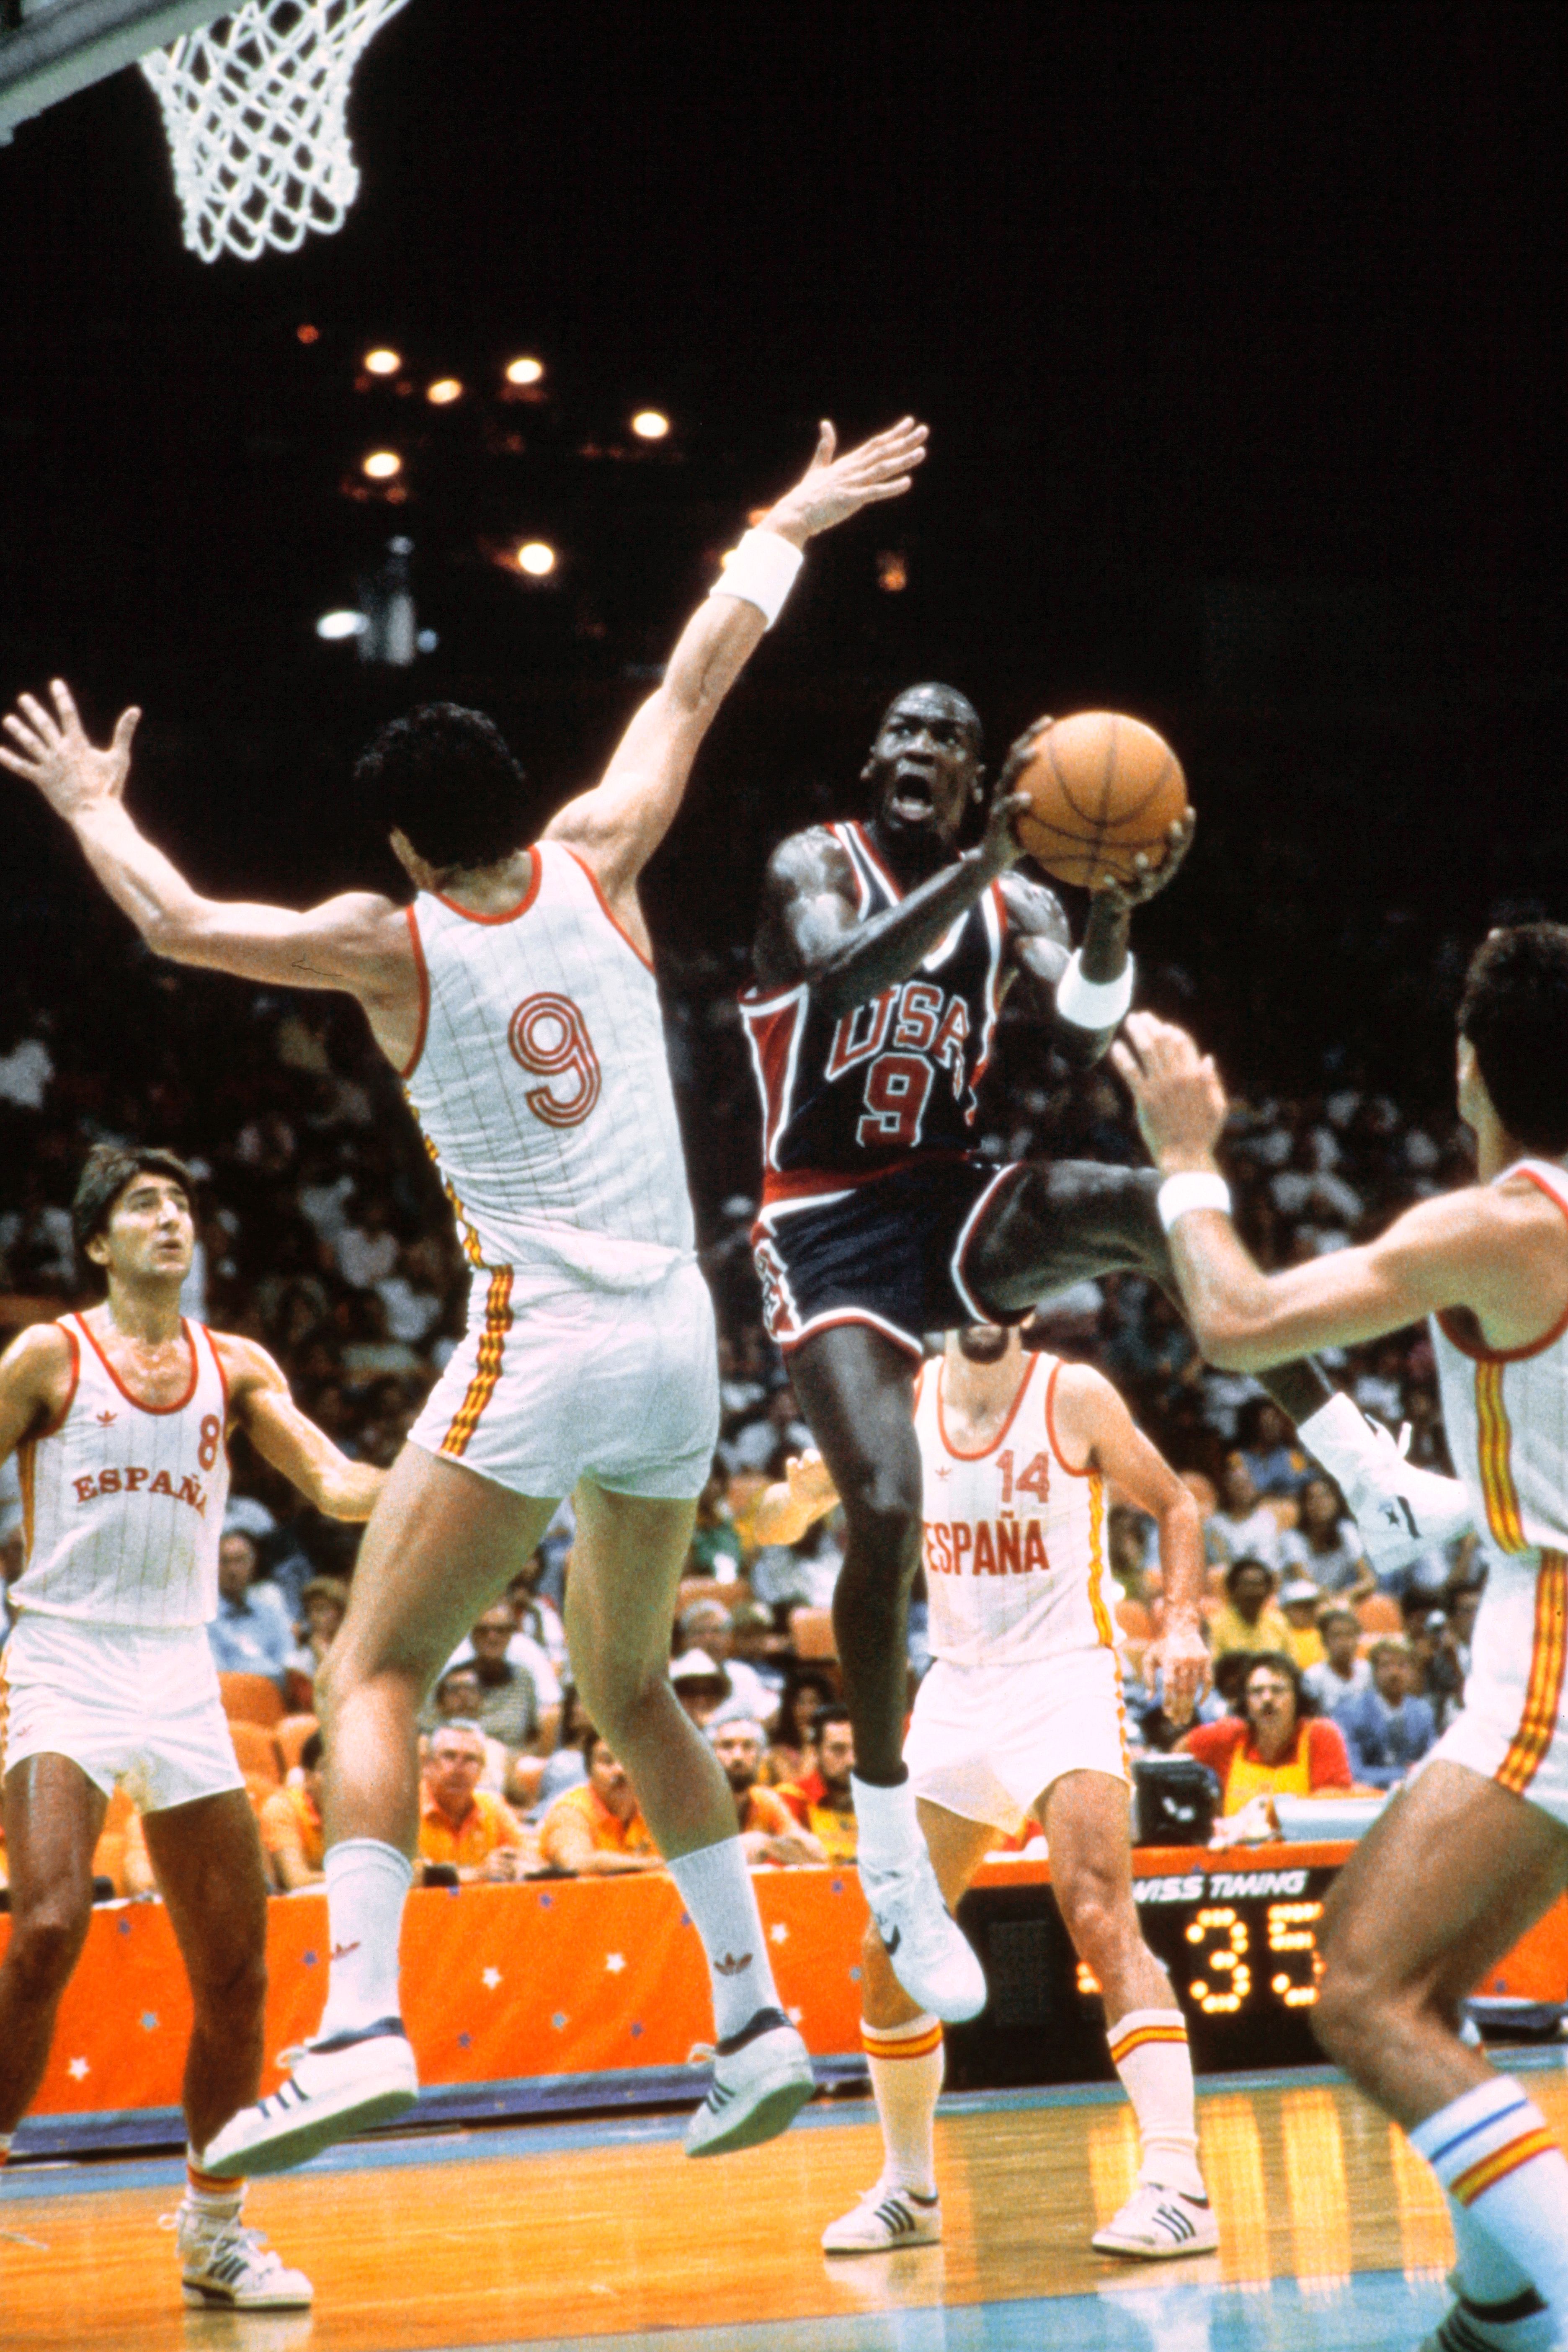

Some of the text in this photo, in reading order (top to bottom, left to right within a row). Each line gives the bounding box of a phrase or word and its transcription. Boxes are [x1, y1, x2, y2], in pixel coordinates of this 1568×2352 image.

[507, 991, 602, 1128] 9
[825, 980, 970, 1101] USA
[856, 1052, 935, 1148] 9
[198, 1414, 220, 1471] 8
[995, 1449, 1050, 1503] 14
[922, 1510, 1050, 1576] ESPAÑA
[1210, 1869, 1308, 1900] TIMING
[1185, 1901, 1324, 2013] 35
